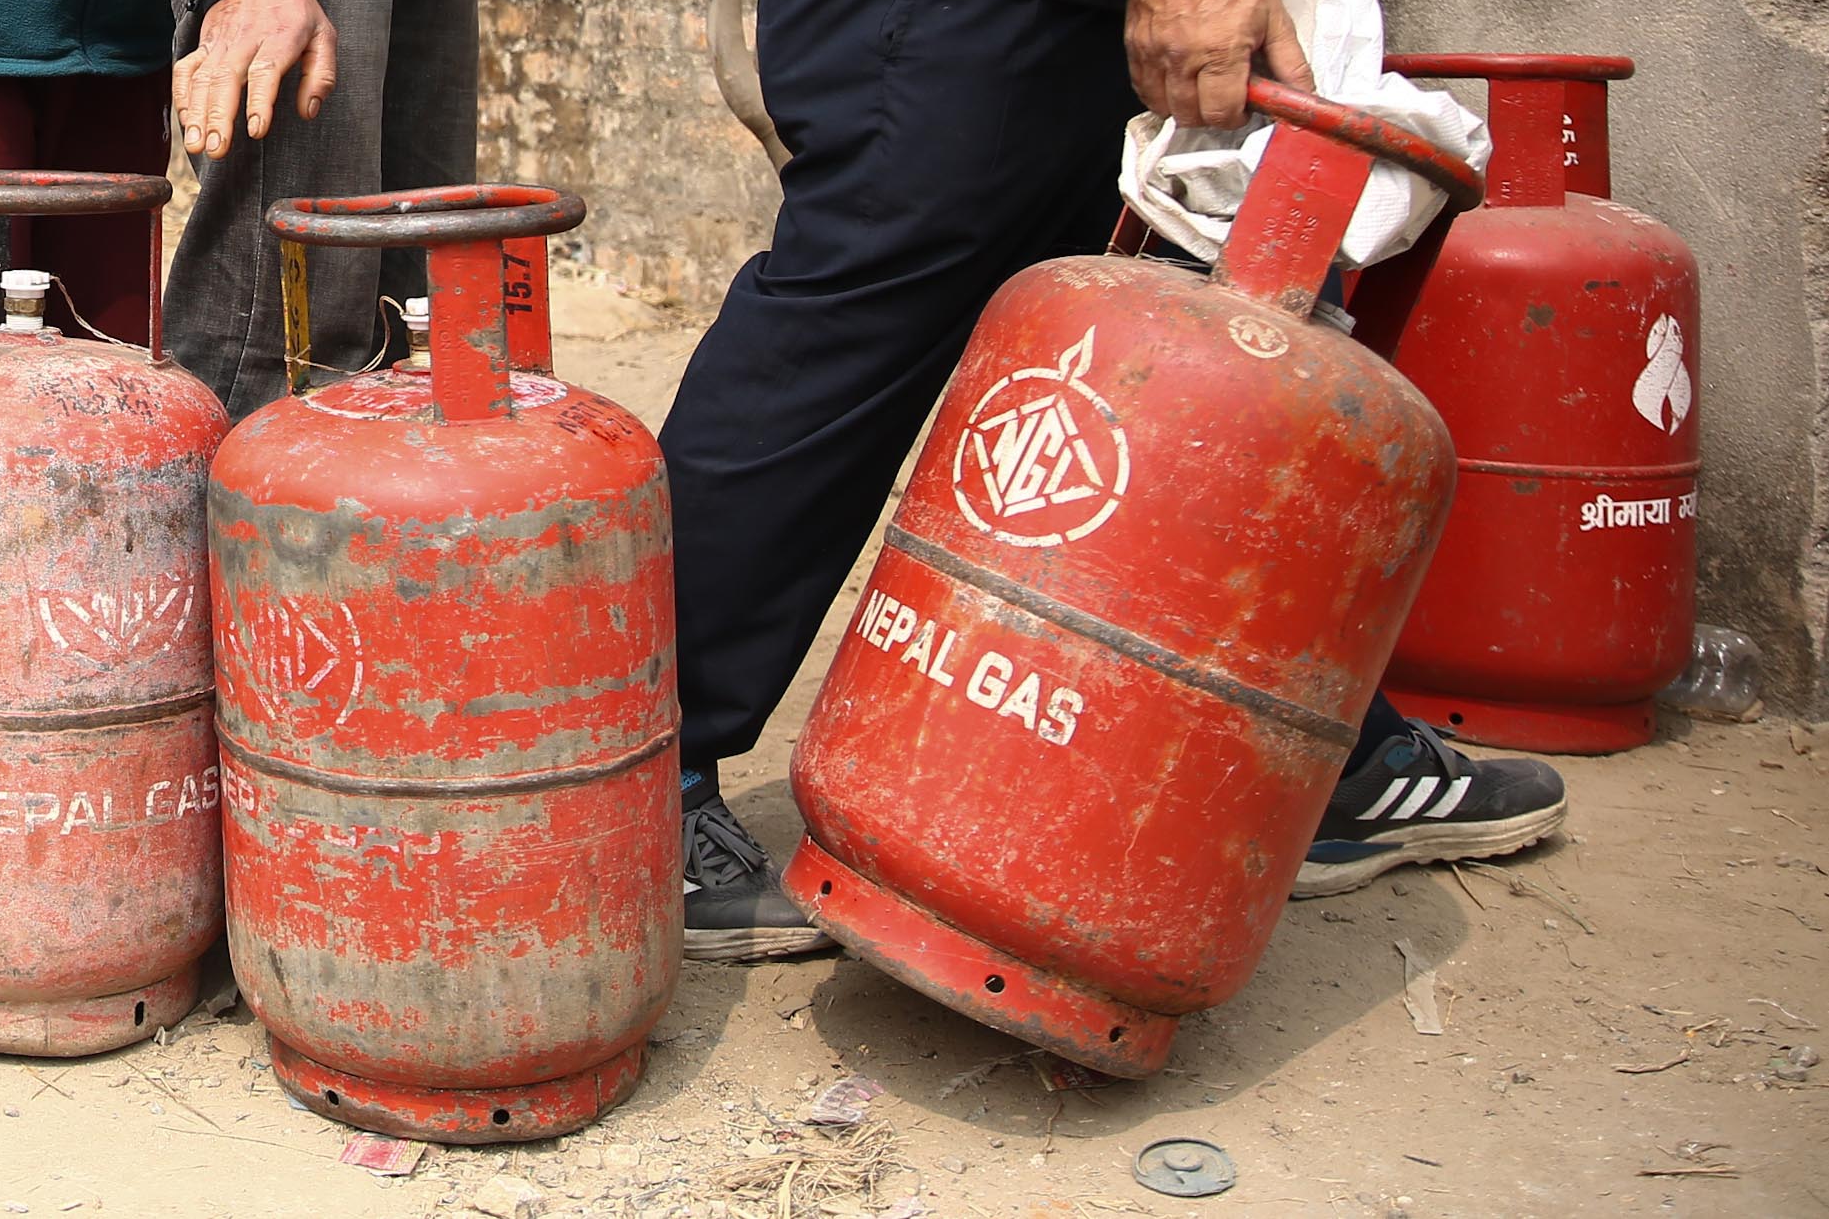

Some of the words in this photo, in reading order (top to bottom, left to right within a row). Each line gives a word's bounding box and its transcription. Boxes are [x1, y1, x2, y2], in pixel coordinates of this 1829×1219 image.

[502, 252, 533, 315] 15.7
[1580, 493, 1671, 531] श्रीमाया
[856, 589, 957, 688] NEPAL
[966, 651, 1084, 746] GAS
[146, 765, 220, 821] GAS
